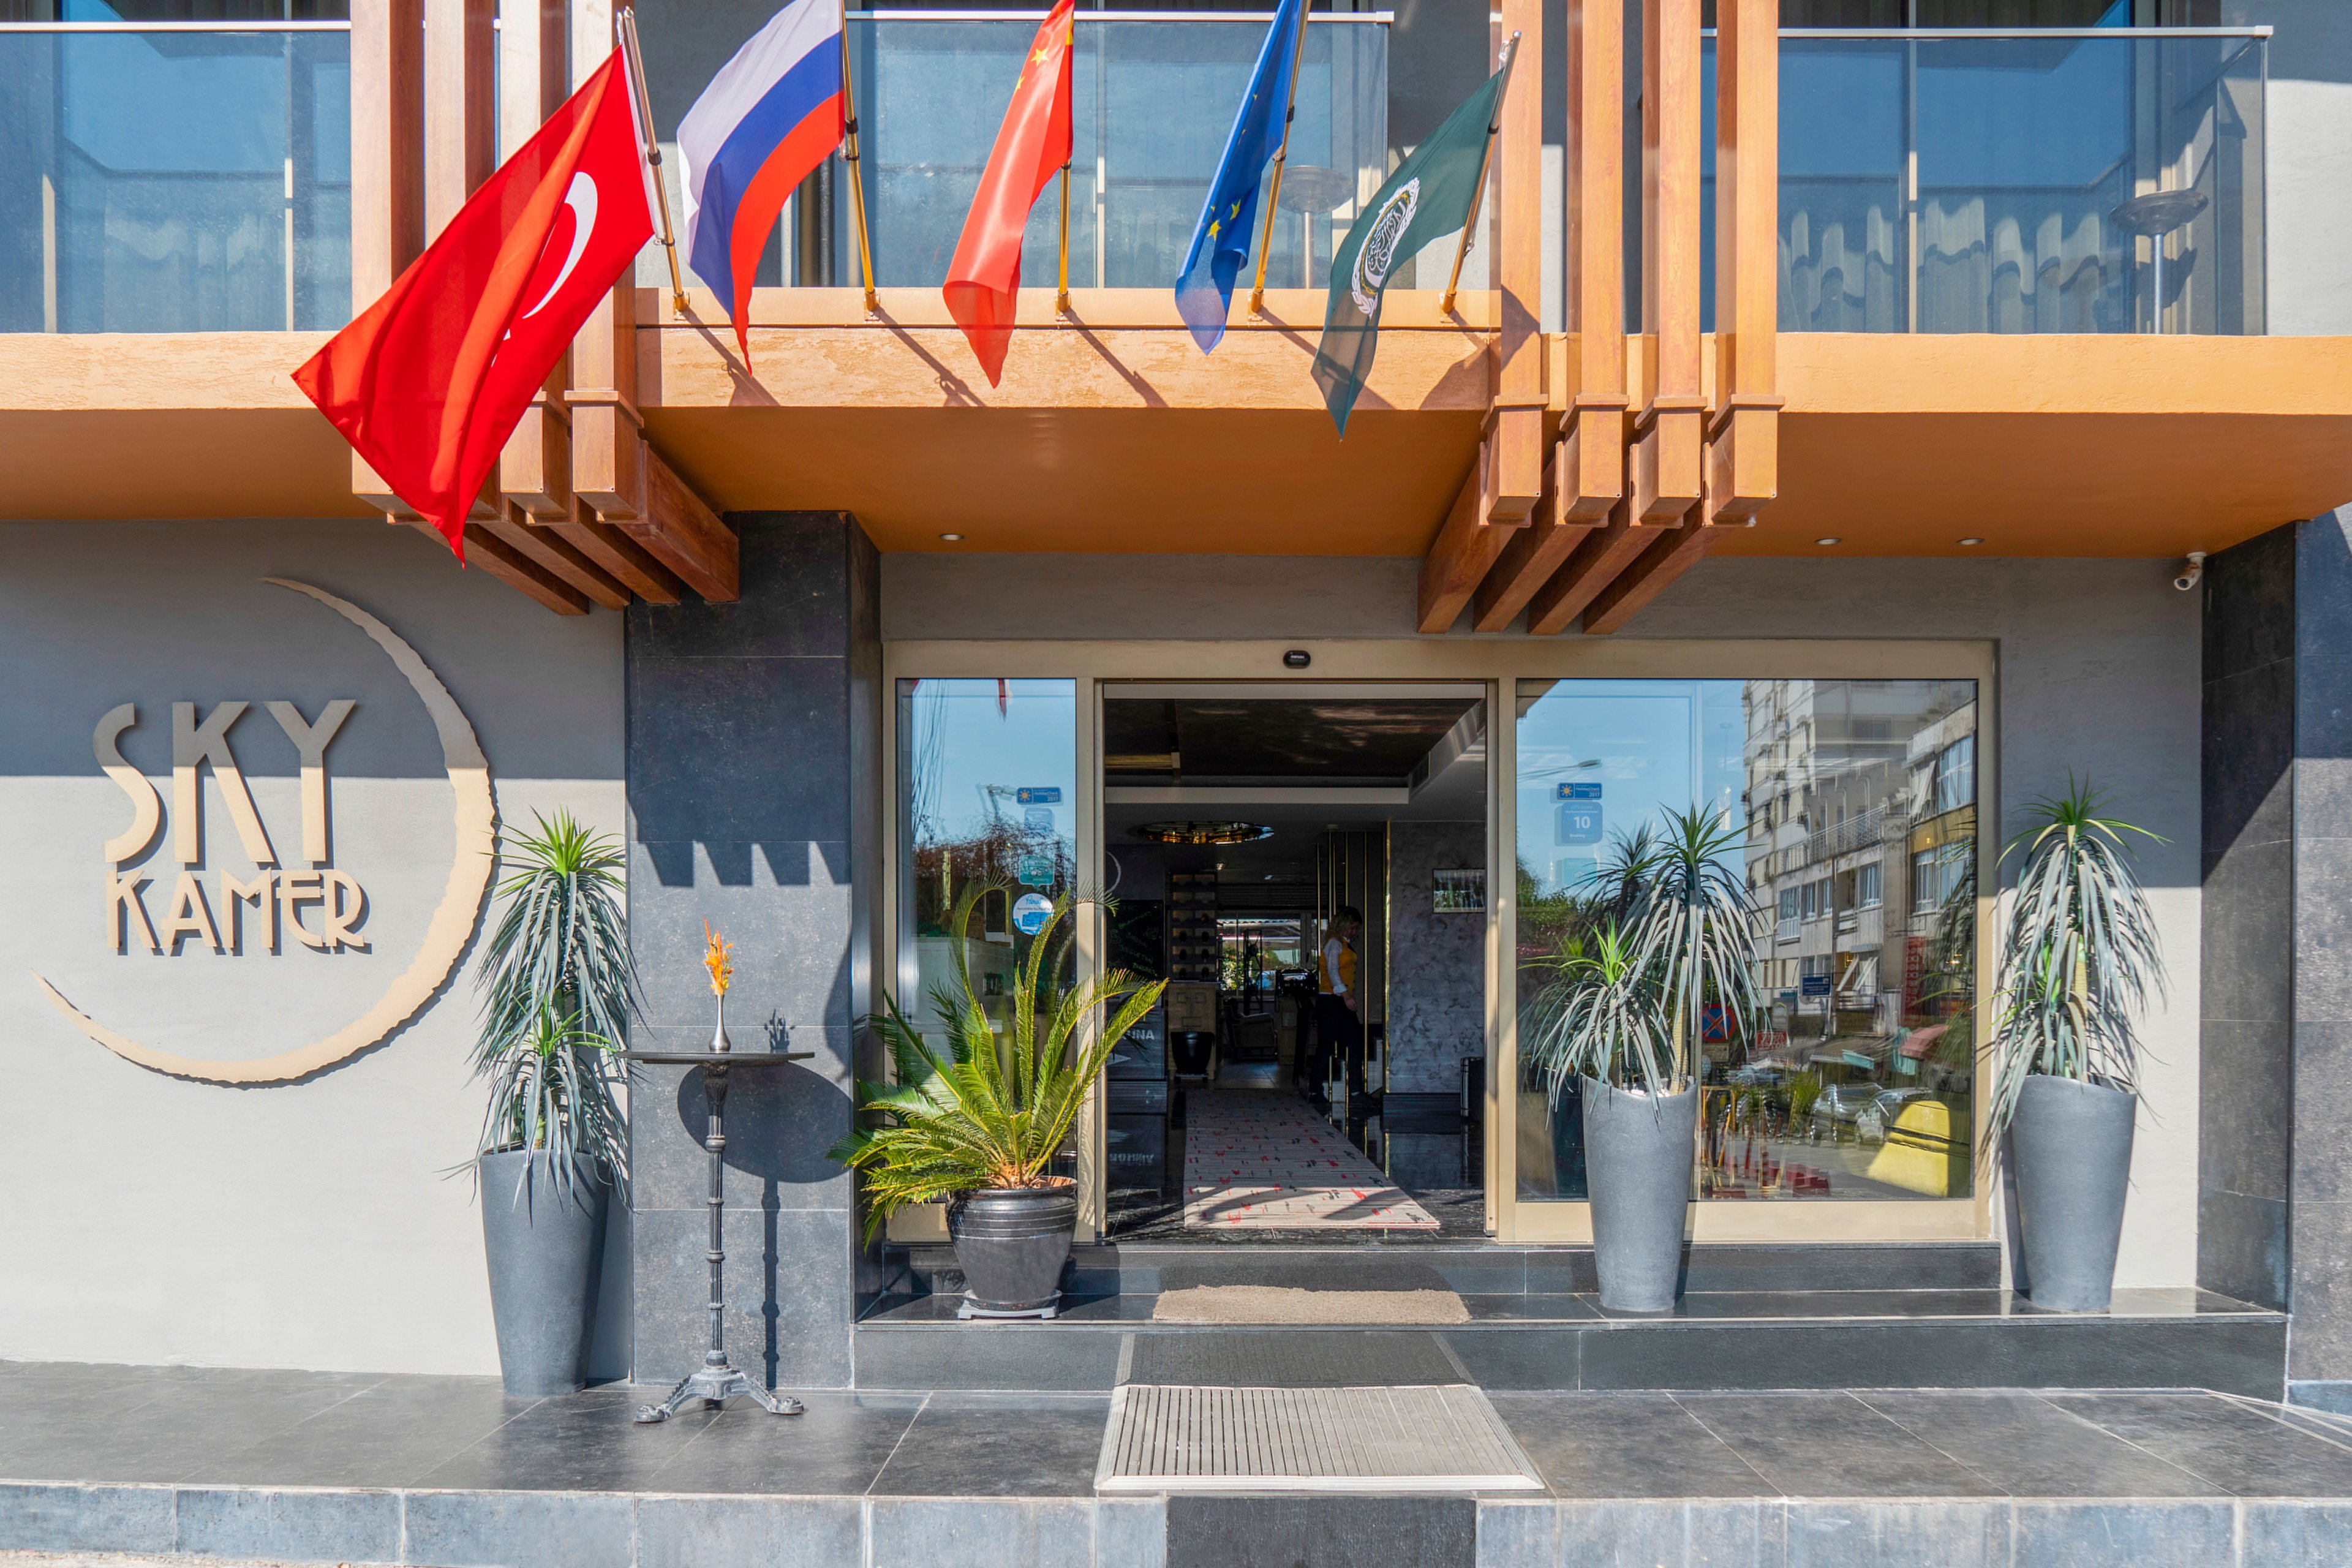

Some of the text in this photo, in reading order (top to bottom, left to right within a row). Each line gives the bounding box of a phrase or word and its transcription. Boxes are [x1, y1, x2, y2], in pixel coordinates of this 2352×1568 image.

[92, 699, 357, 864] SKY
[1574, 816, 1591, 829] 10
[105, 867, 365, 949] KAMER
